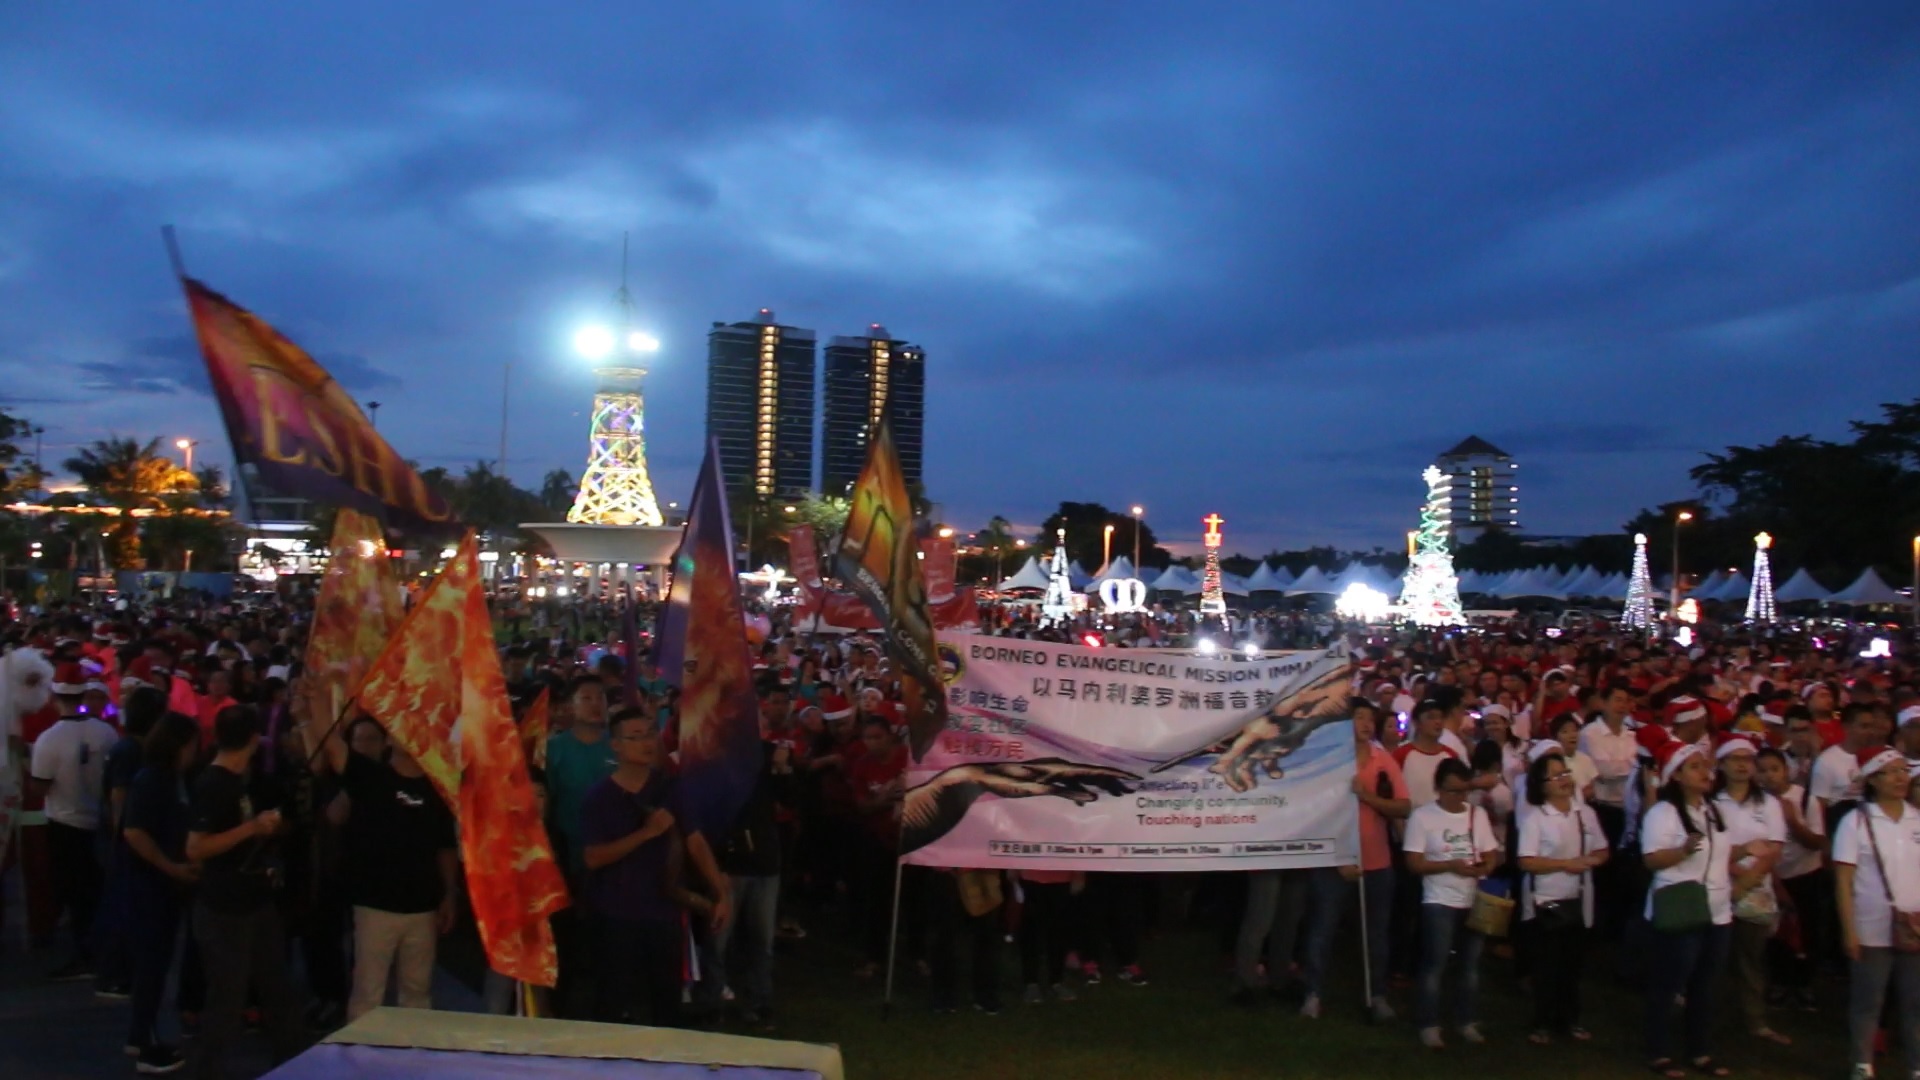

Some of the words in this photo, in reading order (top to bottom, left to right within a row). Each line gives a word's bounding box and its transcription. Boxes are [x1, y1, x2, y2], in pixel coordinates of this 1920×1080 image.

[971, 645, 1047, 665] BORNEO
[1057, 654, 1177, 679] EVANGELICAL
[1185, 667, 1260, 683] MISSION
[1136, 797, 1203, 810] Changing
[1136, 814, 1202, 828] Touching
[1205, 813, 1257, 825] nations
